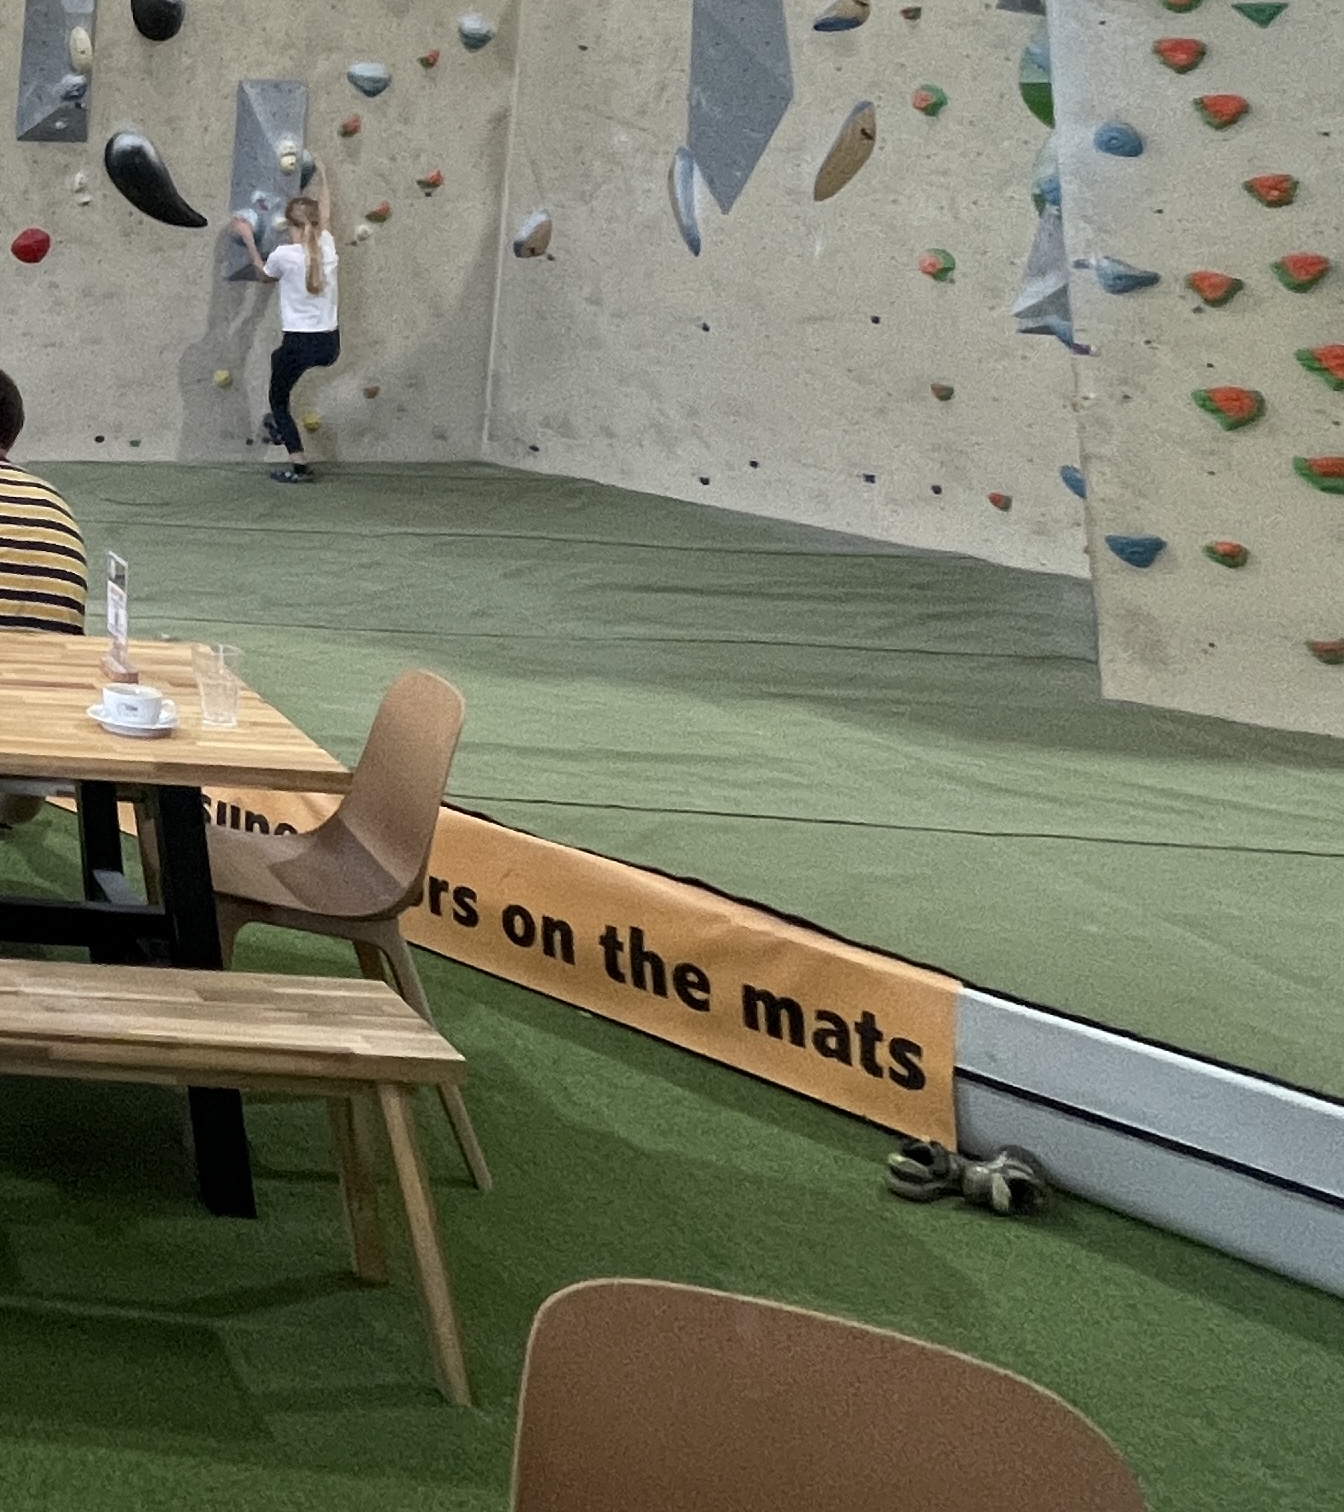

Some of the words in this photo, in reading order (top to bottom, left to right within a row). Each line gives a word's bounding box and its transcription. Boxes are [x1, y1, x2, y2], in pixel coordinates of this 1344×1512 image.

[501, 903, 576, 966] on
[598, 924, 712, 1013] the
[741, 983, 927, 1091] mats
